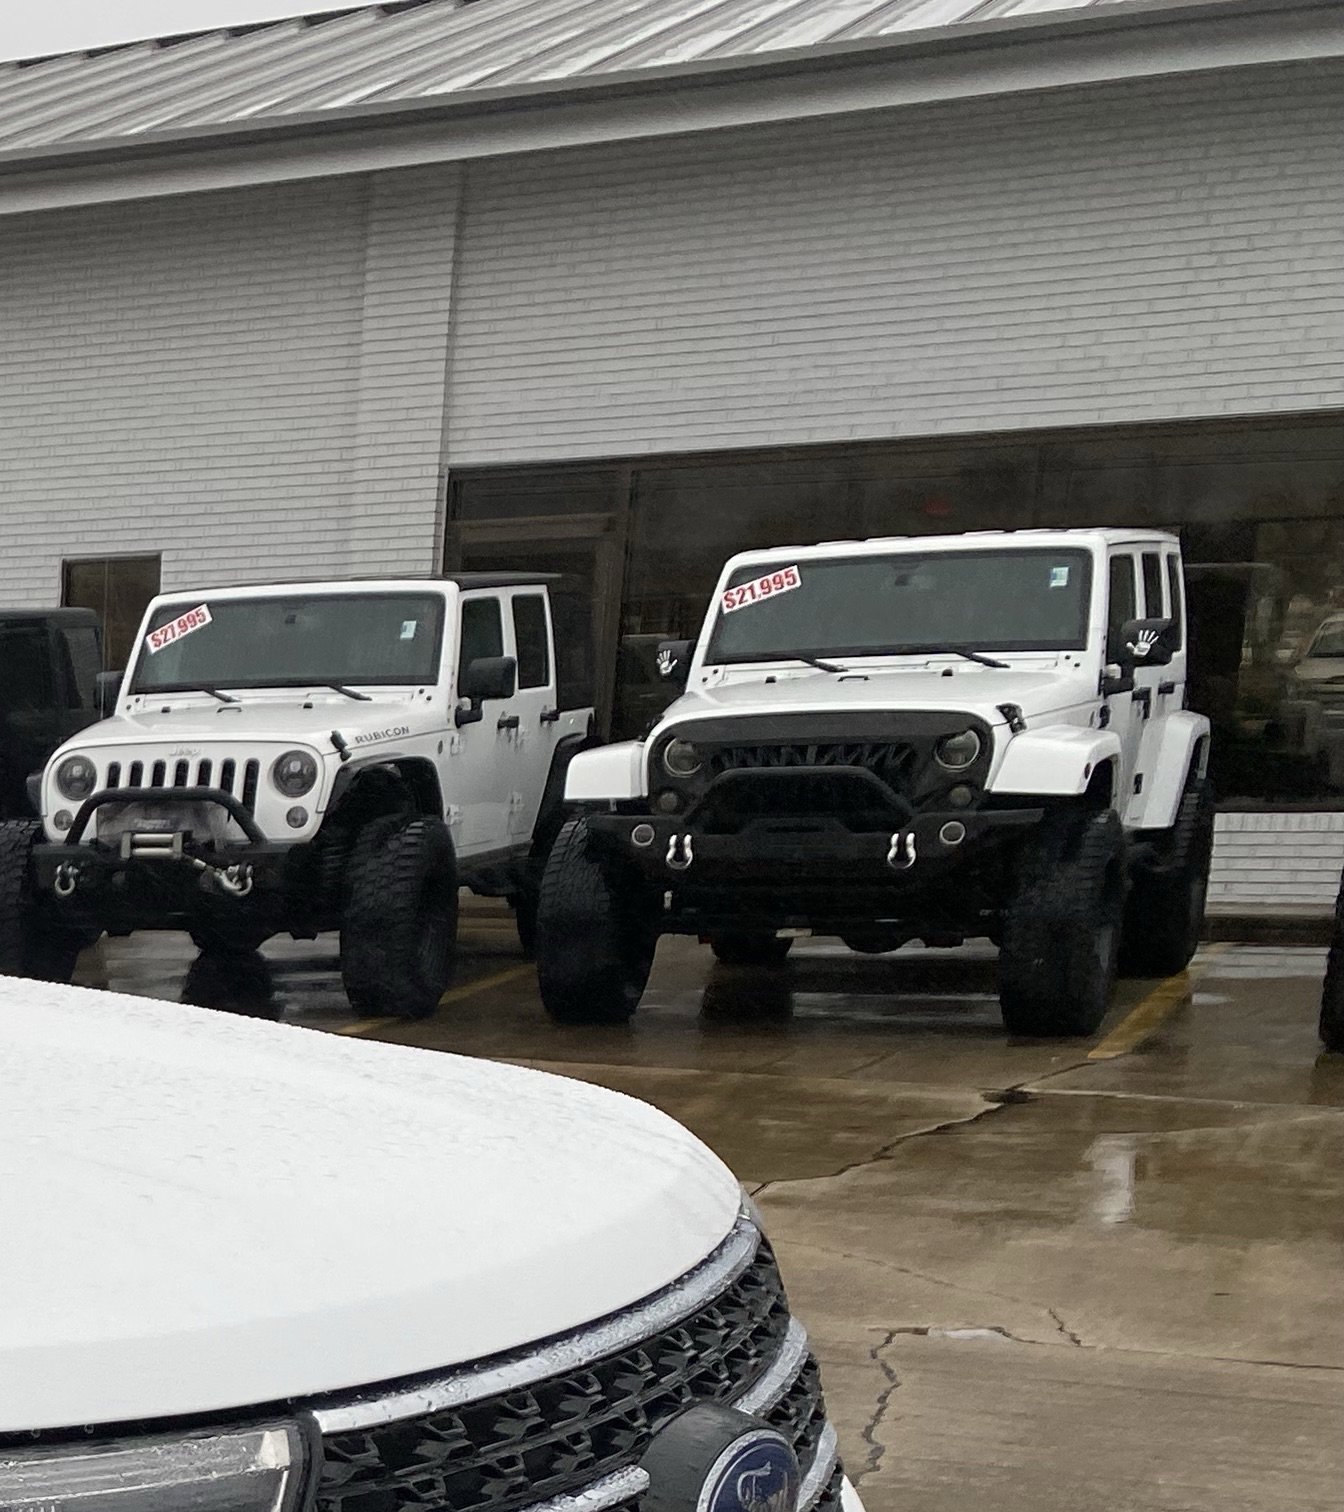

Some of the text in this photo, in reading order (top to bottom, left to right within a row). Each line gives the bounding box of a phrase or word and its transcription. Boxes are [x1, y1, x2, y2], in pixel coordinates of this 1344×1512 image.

[723, 568, 798, 609] $21,995
[150, 607, 207, 648] $27,995
[354, 726, 410, 744] RUBICON
